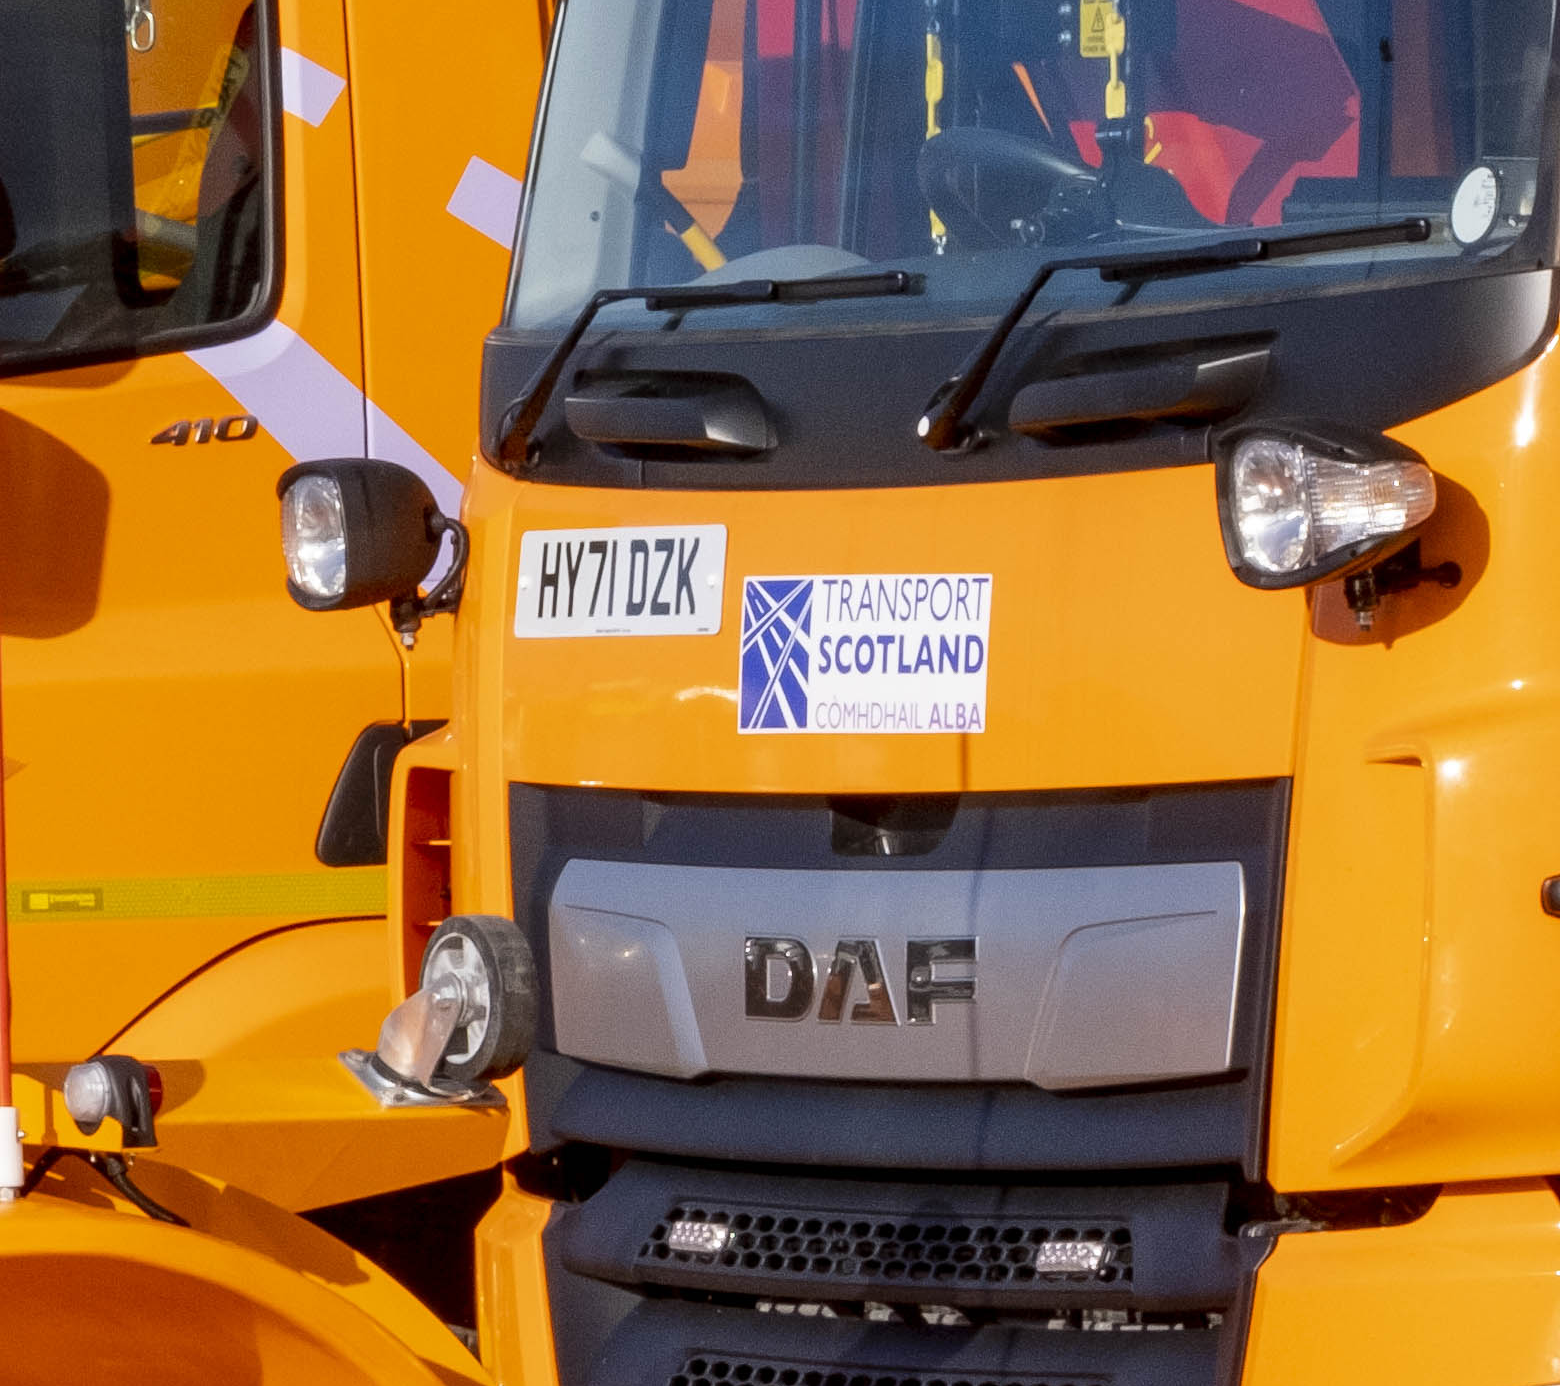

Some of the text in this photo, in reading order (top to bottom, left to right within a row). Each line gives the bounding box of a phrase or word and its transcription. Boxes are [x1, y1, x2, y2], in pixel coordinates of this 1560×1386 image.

[149, 414, 258, 445] 410
[537, 537, 701, 618] HY71 DZK
[822, 578, 990, 623] TRANSPORT
[818, 634, 984, 674] SCOTLAND
[928, 702, 982, 730] ALBA
[743, 934, 980, 1027] DAF
